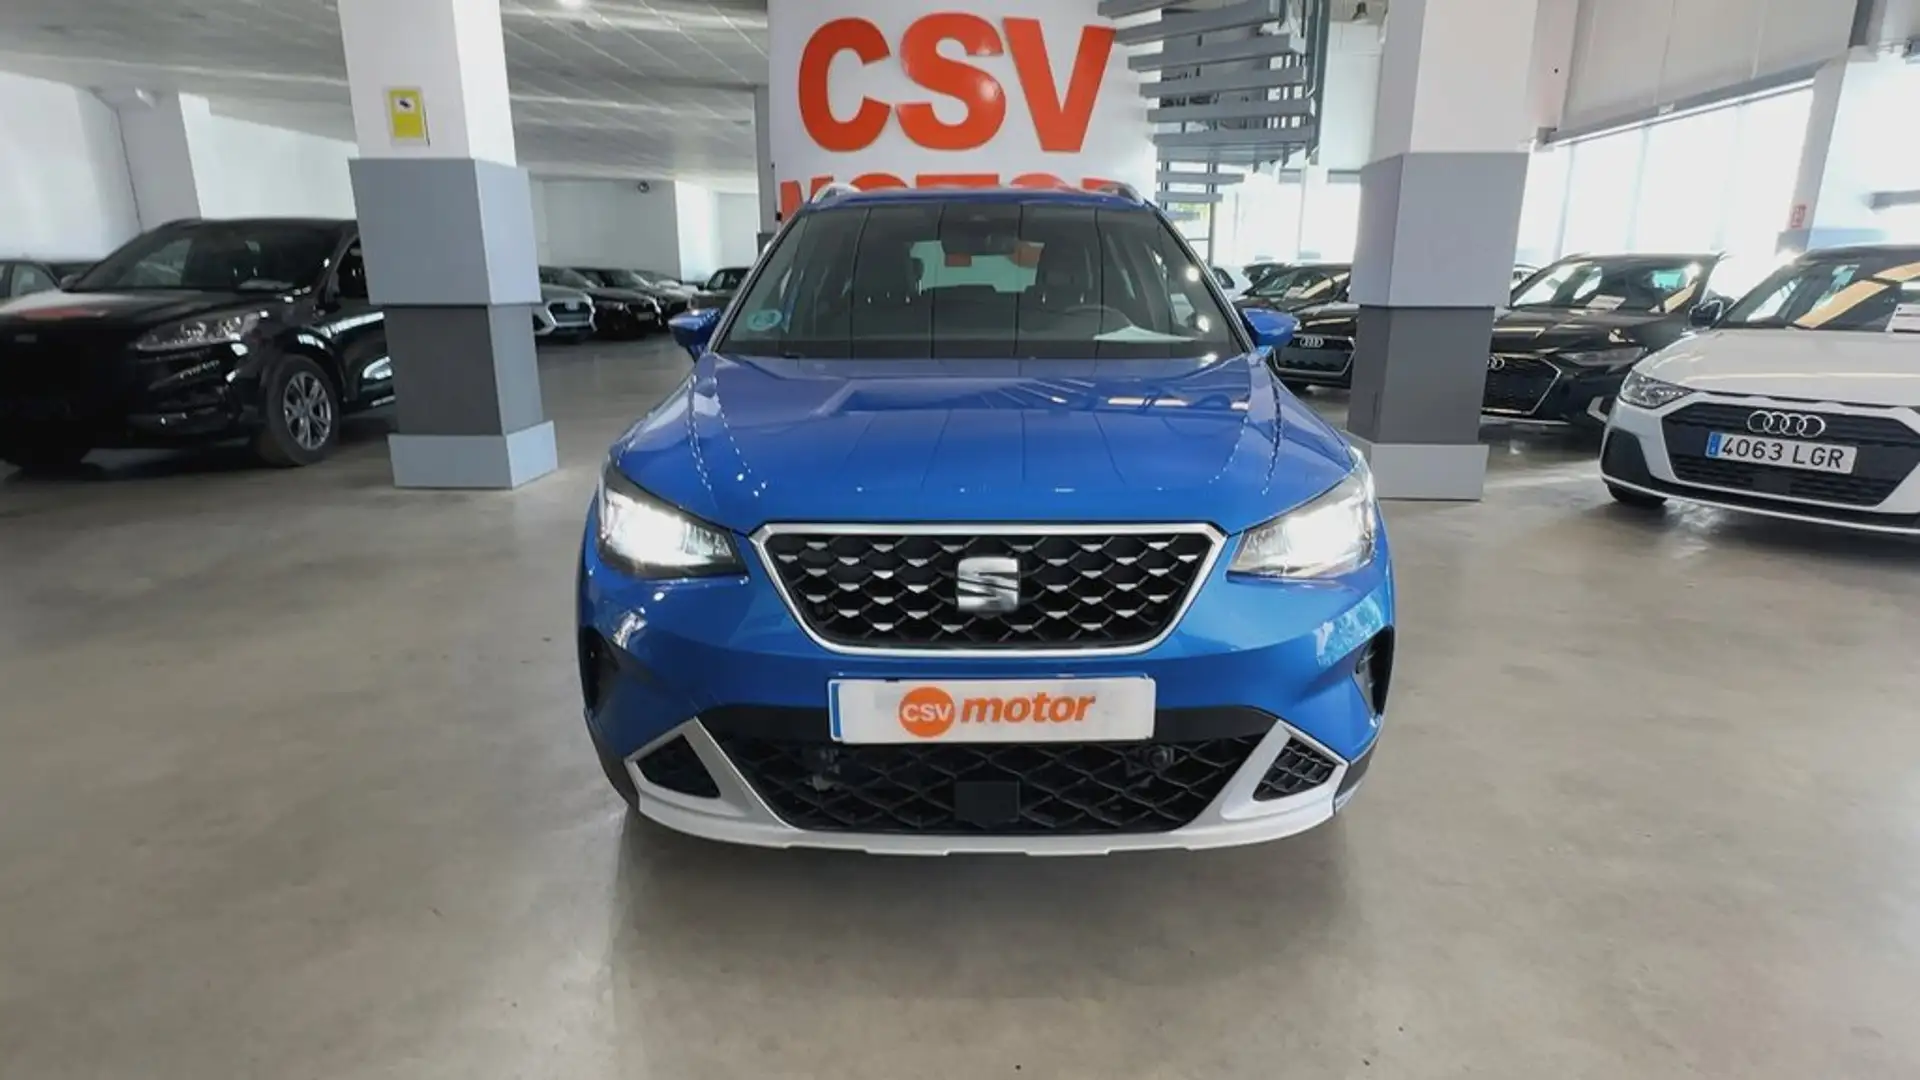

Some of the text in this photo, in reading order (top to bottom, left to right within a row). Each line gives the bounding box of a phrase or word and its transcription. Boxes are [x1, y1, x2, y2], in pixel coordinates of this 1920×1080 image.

[798, 13, 1117, 153] CSV
[1722, 437, 1844, 469] 4063 LGR
[902, 692, 1096, 723] CSV motor
